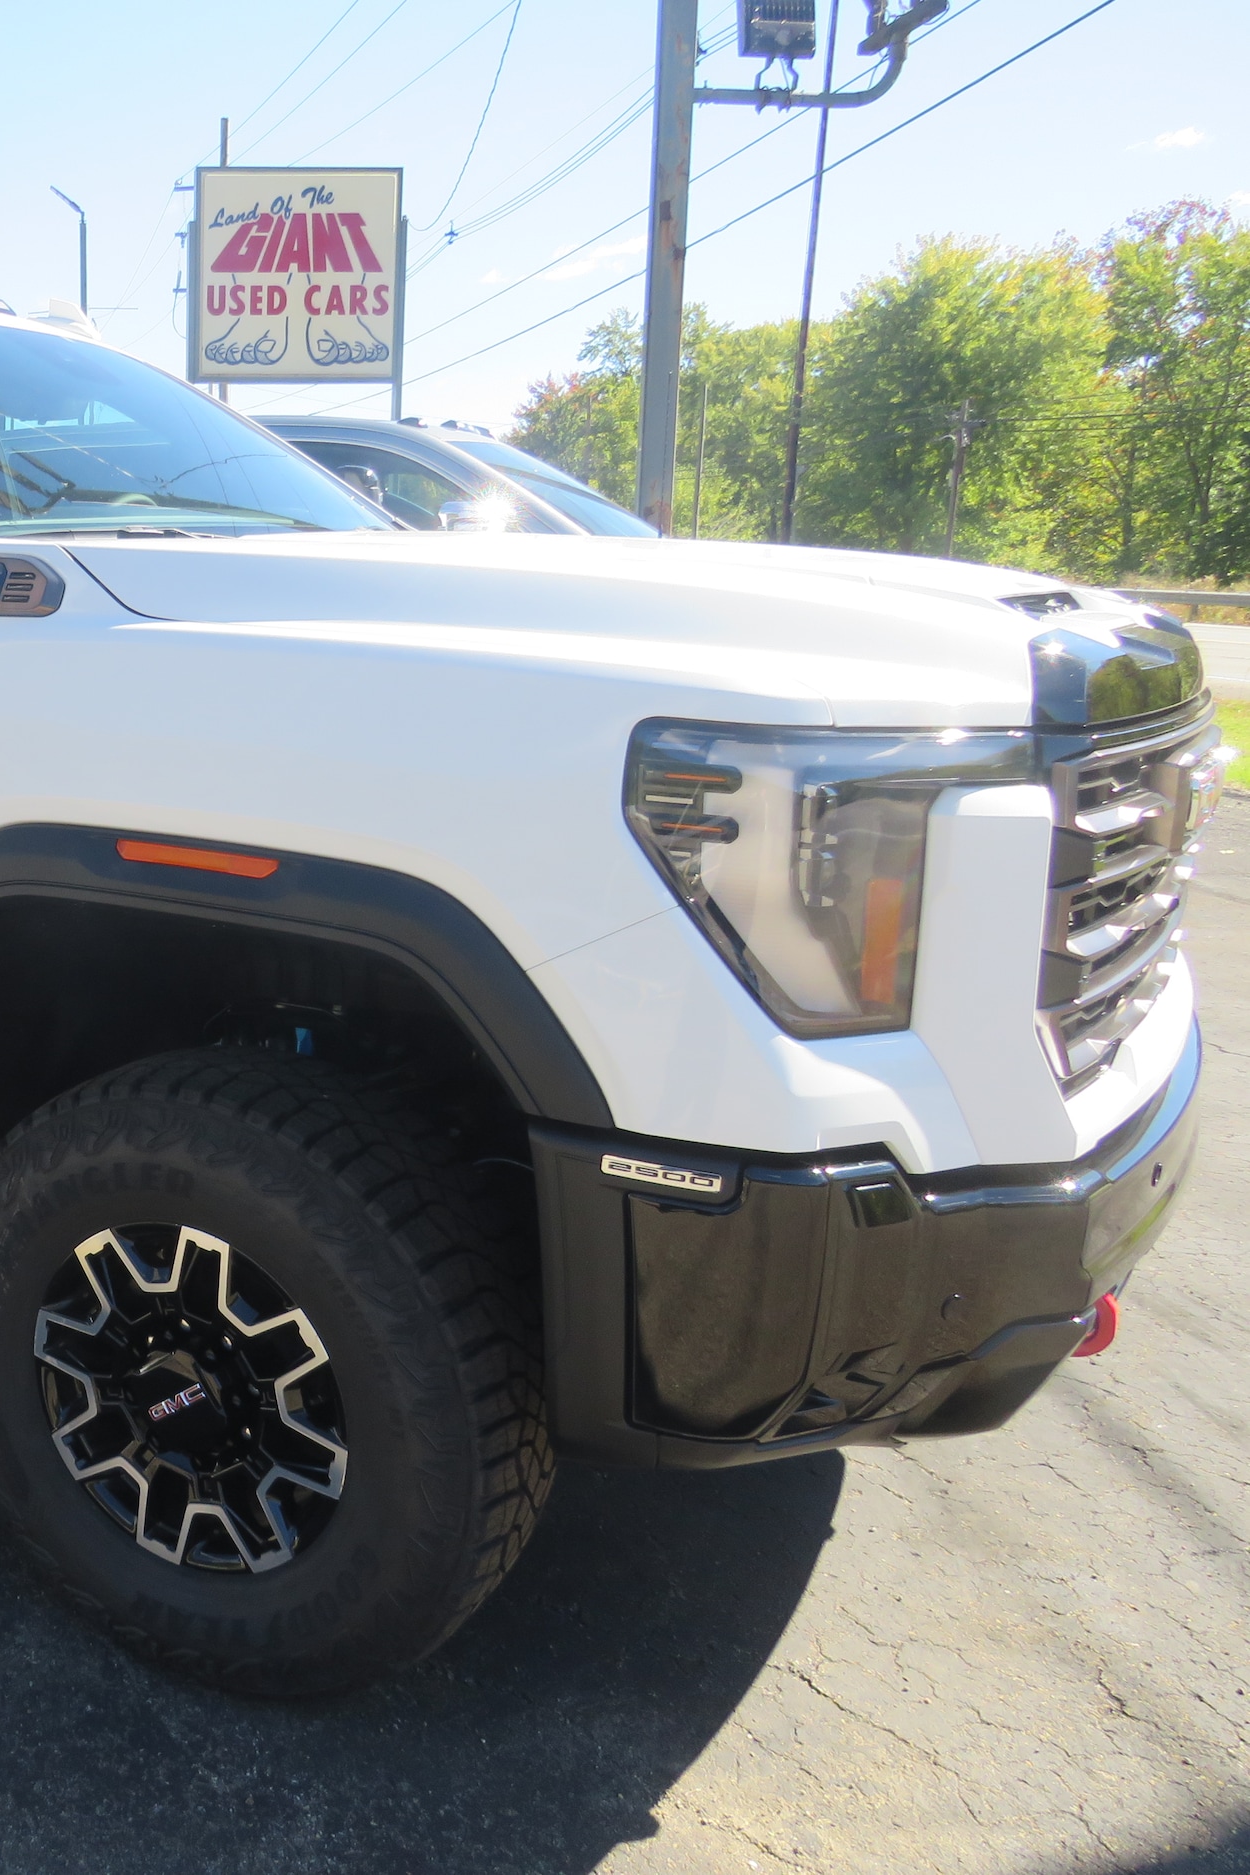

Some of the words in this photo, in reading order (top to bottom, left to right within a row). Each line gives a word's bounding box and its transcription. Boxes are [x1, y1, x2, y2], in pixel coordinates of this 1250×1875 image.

[208, 203, 259, 229] Land
[270, 194, 292, 220] Of
[301, 185, 334, 208] The
[210, 212, 383, 273] GIANT
[206, 284, 288, 316] USED
[304, 284, 389, 316] CARS
[607, 1161, 714, 1188] 2500
[148, 1383, 206, 1421] GMC
